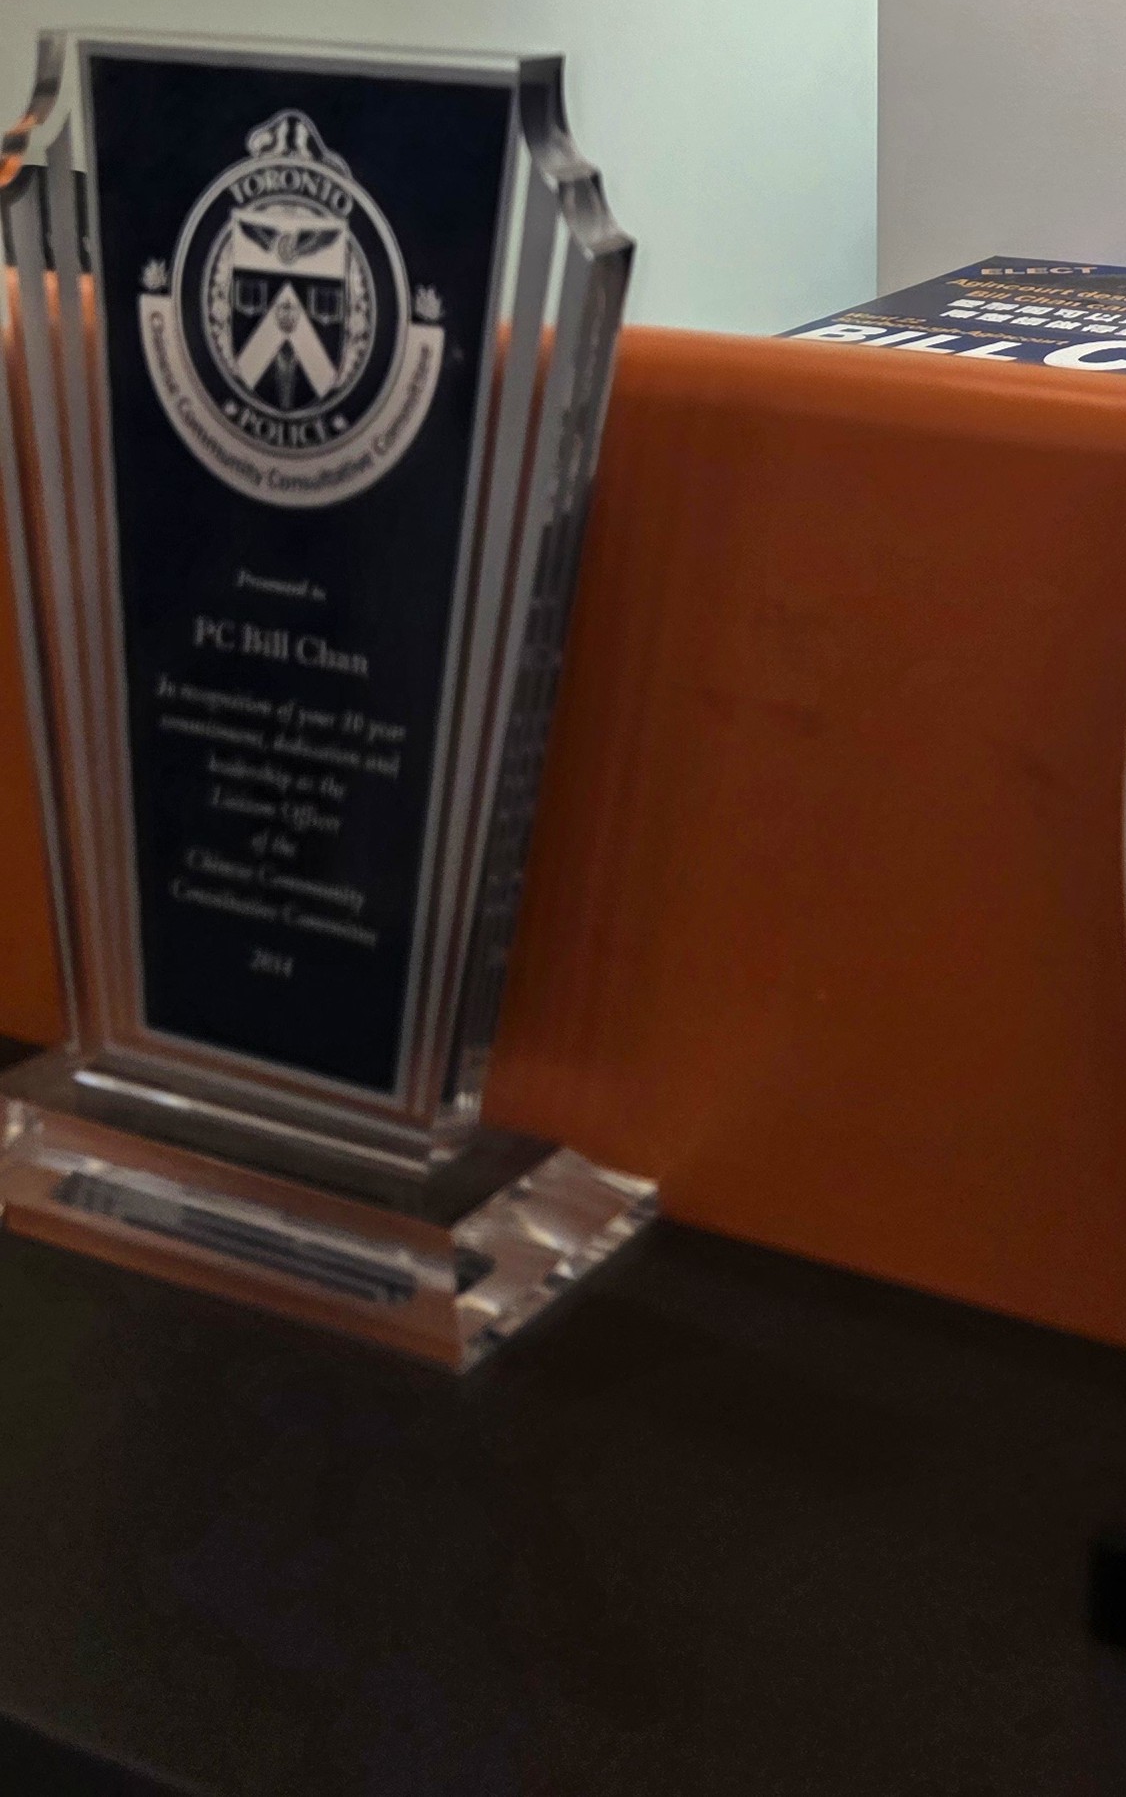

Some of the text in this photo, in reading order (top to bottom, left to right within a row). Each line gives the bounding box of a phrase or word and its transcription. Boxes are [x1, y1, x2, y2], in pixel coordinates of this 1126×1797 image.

[229, 165, 354, 218] TORONTO
[946, 277, 1077, 299] Agincourt
[980, 266, 1098, 277] ELECT
[965, 288, 1013, 302] Bill
[1014, 294, 1086, 309] Chan
[787, 323, 1023, 362] BILL
[239, 409, 330, 450] POLICE
[193, 615, 370, 678] PC Bill Chan
